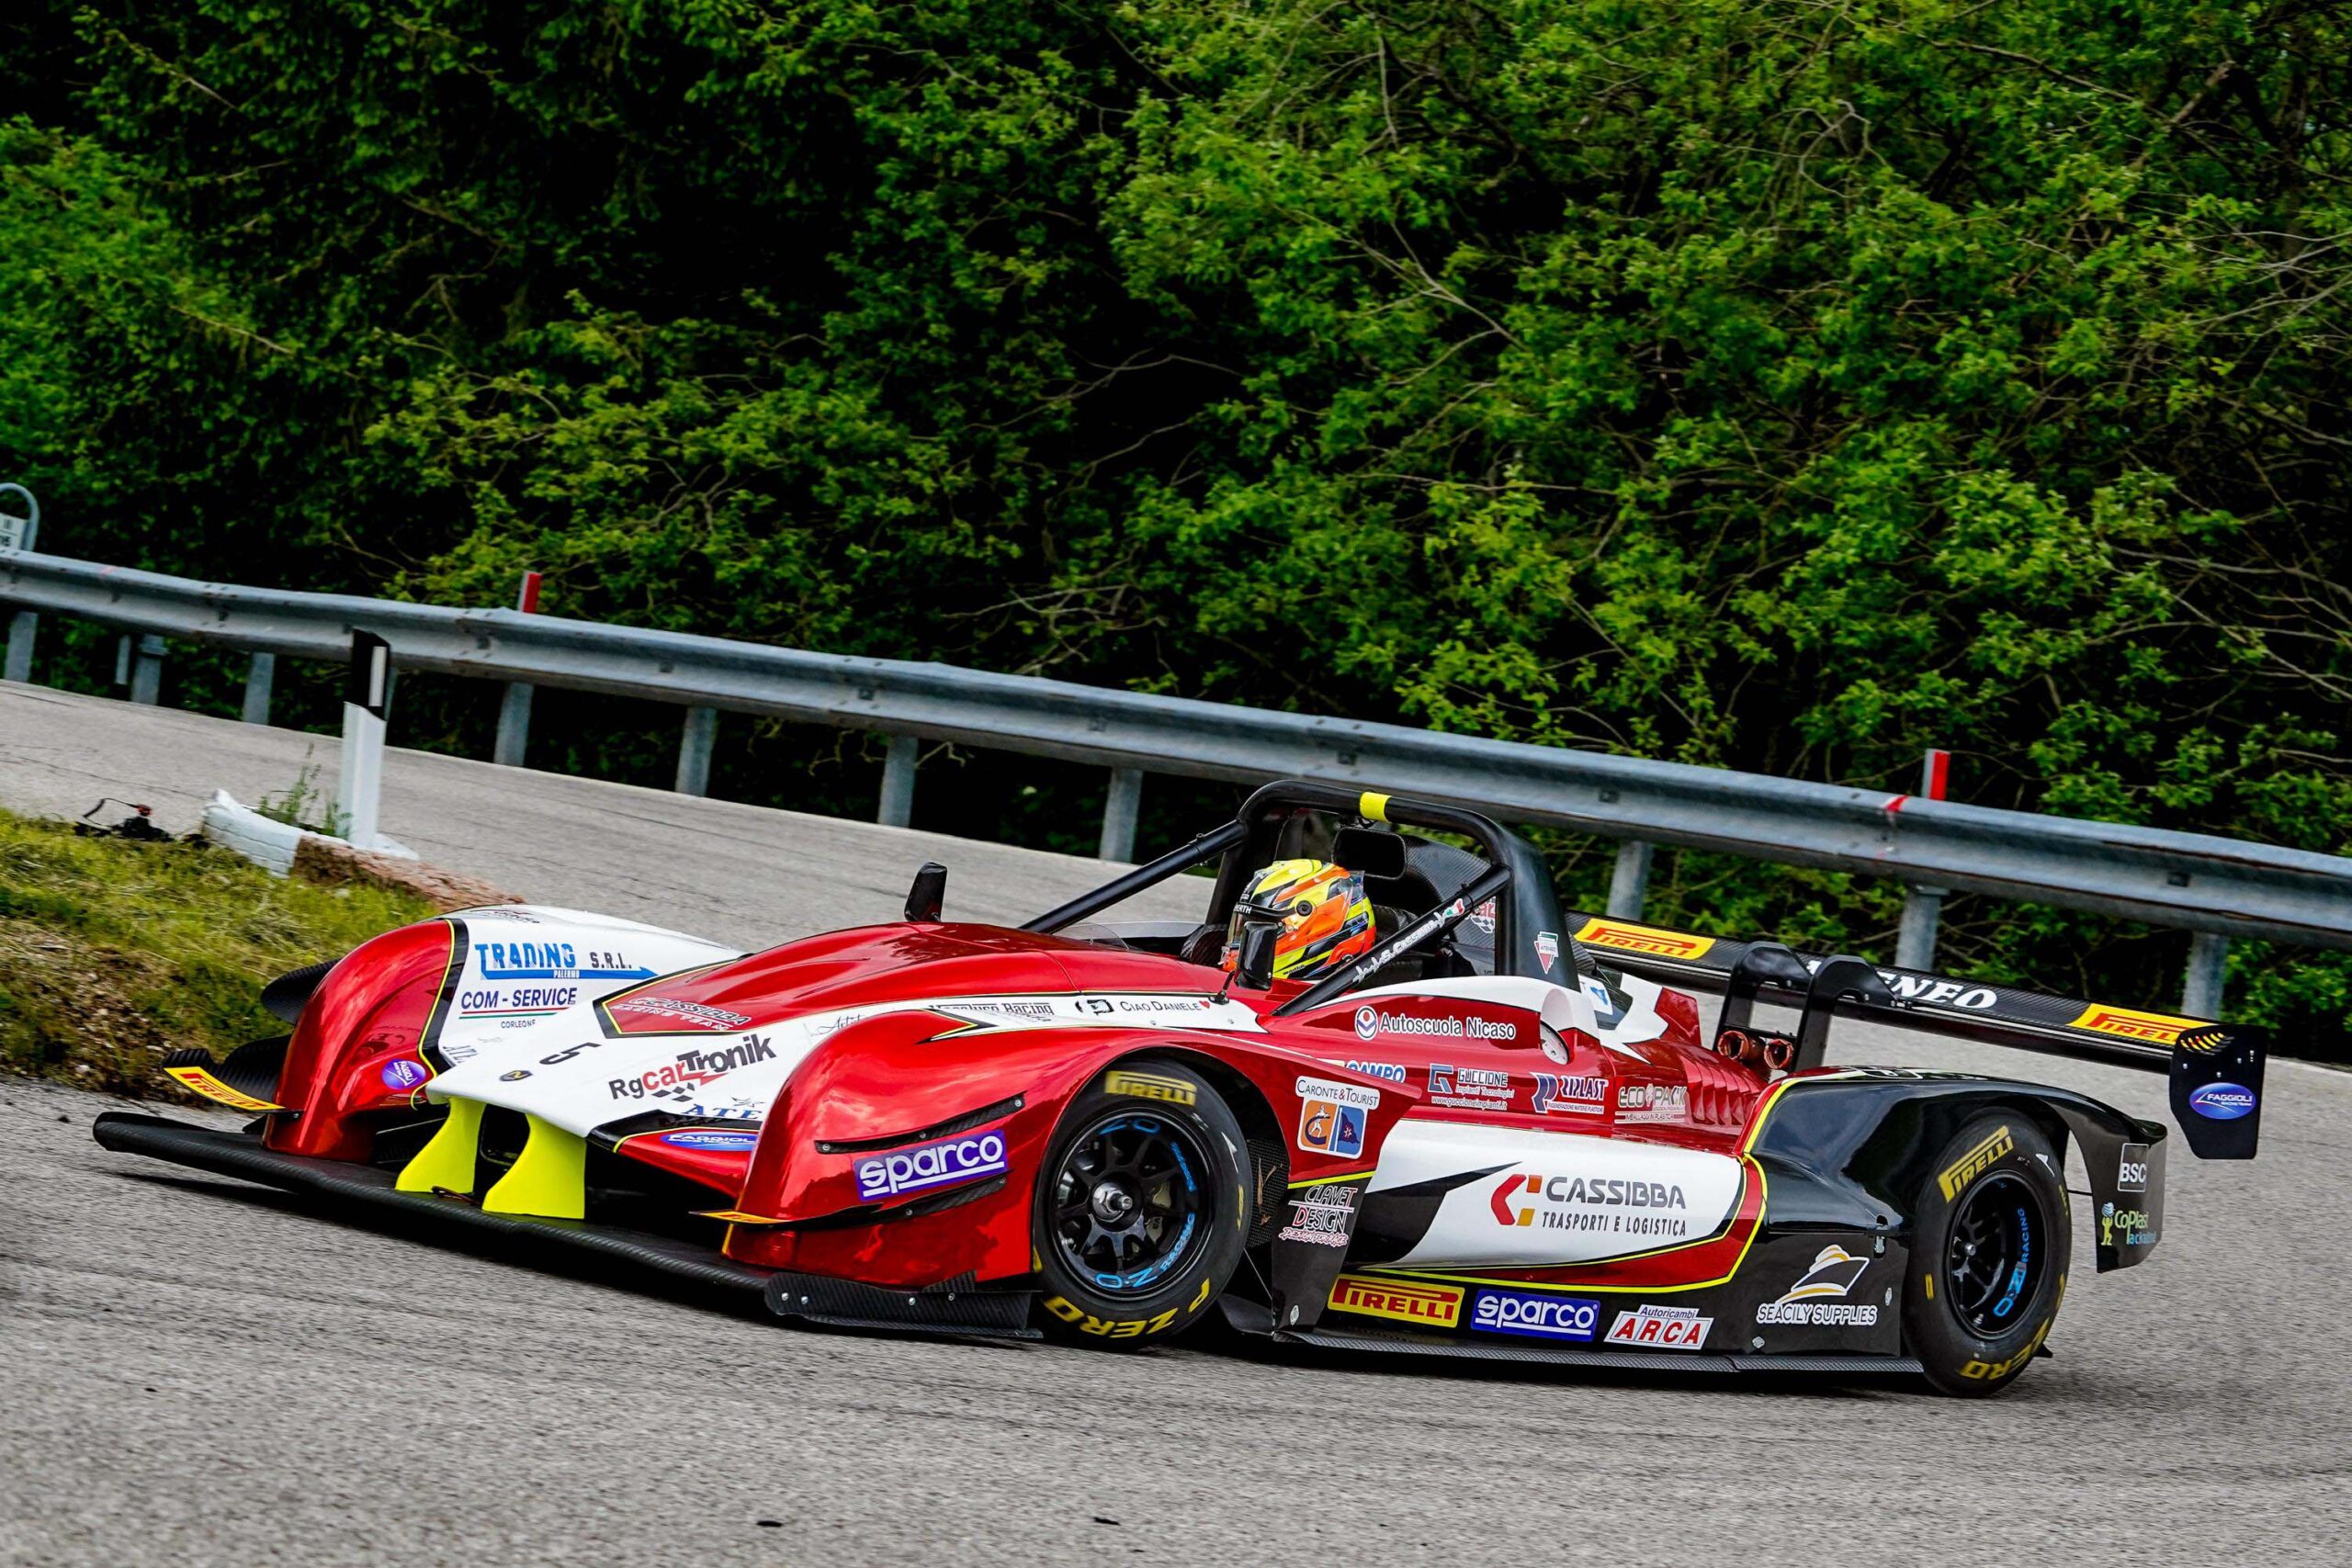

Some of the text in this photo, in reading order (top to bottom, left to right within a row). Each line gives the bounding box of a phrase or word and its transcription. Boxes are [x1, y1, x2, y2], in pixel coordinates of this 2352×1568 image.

[474, 942, 632, 969] TRADING S.R.L.
[1586, 927, 1697, 956] PIRELLI
[553, 969, 580, 979] PALERMO
[461, 991, 499, 1010] COM
[512, 987, 577, 1008] SERVICE
[1379, 1013, 1516, 1039] Autoscuola Nicaso
[2086, 1012, 2192, 1043] PIREL
[179, 1072, 268, 1108] PIRELLI
[1105, 1070, 1197, 1106] PIRELLI
[1458, 1069, 1508, 1087] GUCCIONE
[2207, 1093, 2253, 1102] FAGGIOLI
[860, 1135, 1003, 1196] sparco
[1937, 1125, 2014, 1203] PIRELLI
[2120, 1163, 2146, 1183] BSC
[1306, 1185, 1358, 1207] CLAVET
[1546, 1176, 1686, 1210] CASSIBBA
[1293, 1205, 1347, 1234] DESIGN
[1543, 1212, 1687, 1236] TRASPORTI E LOGISTICA
[2017, 1207, 2030, 1263] RACING
[1331, 1278, 1459, 1320] PIRELLI
[1476, 1294, 1595, 1329] sparco
[1640, 1306, 1696, 1319] Autoricambi
[1043, 1296, 1179, 1338] ZERO
[1757, 1304, 1877, 1324] SEACILY SUPPLIES
[1614, 1317, 1702, 1344] ARCA
